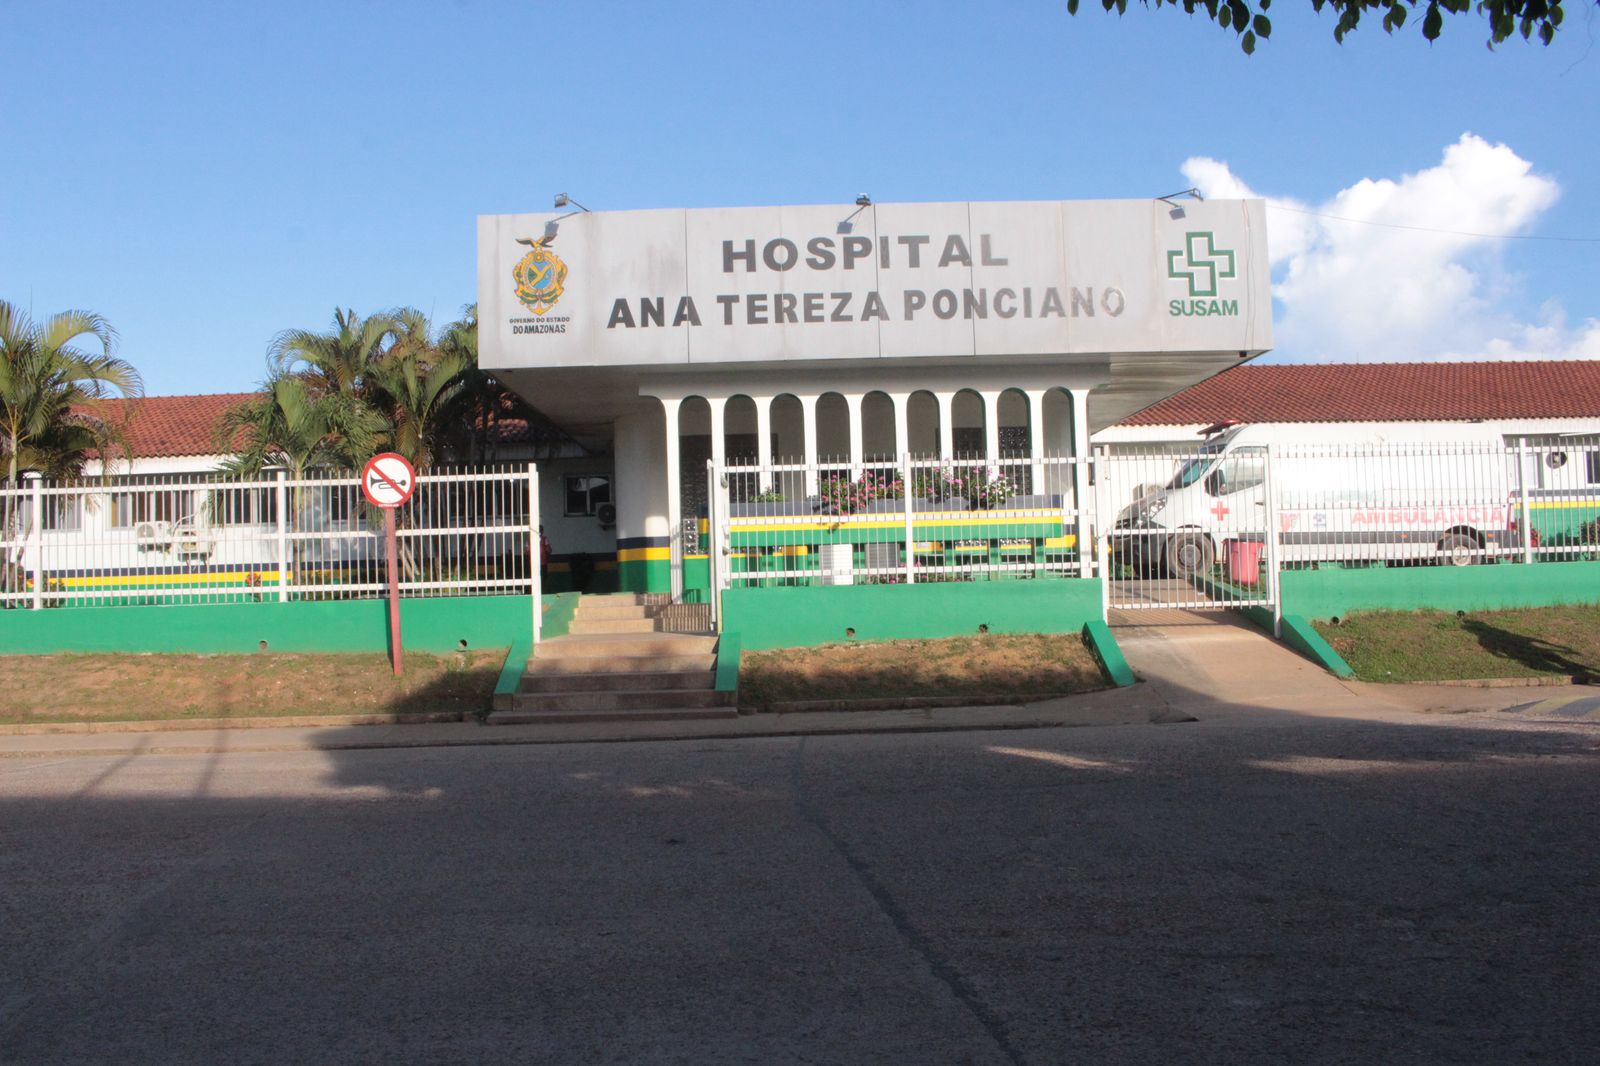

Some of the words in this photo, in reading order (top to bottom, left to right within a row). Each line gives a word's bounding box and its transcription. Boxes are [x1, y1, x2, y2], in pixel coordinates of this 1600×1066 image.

[722, 233, 1009, 273] HOSPITAL
[606, 295, 703, 329] ANA
[716, 290, 890, 326] TEREZA
[903, 285, 1125, 322] PONCIANO
[1169, 299, 1239, 316] SUSAM
[513, 325, 523, 334] DO
[524, 324, 566, 334] AMAZONAS
